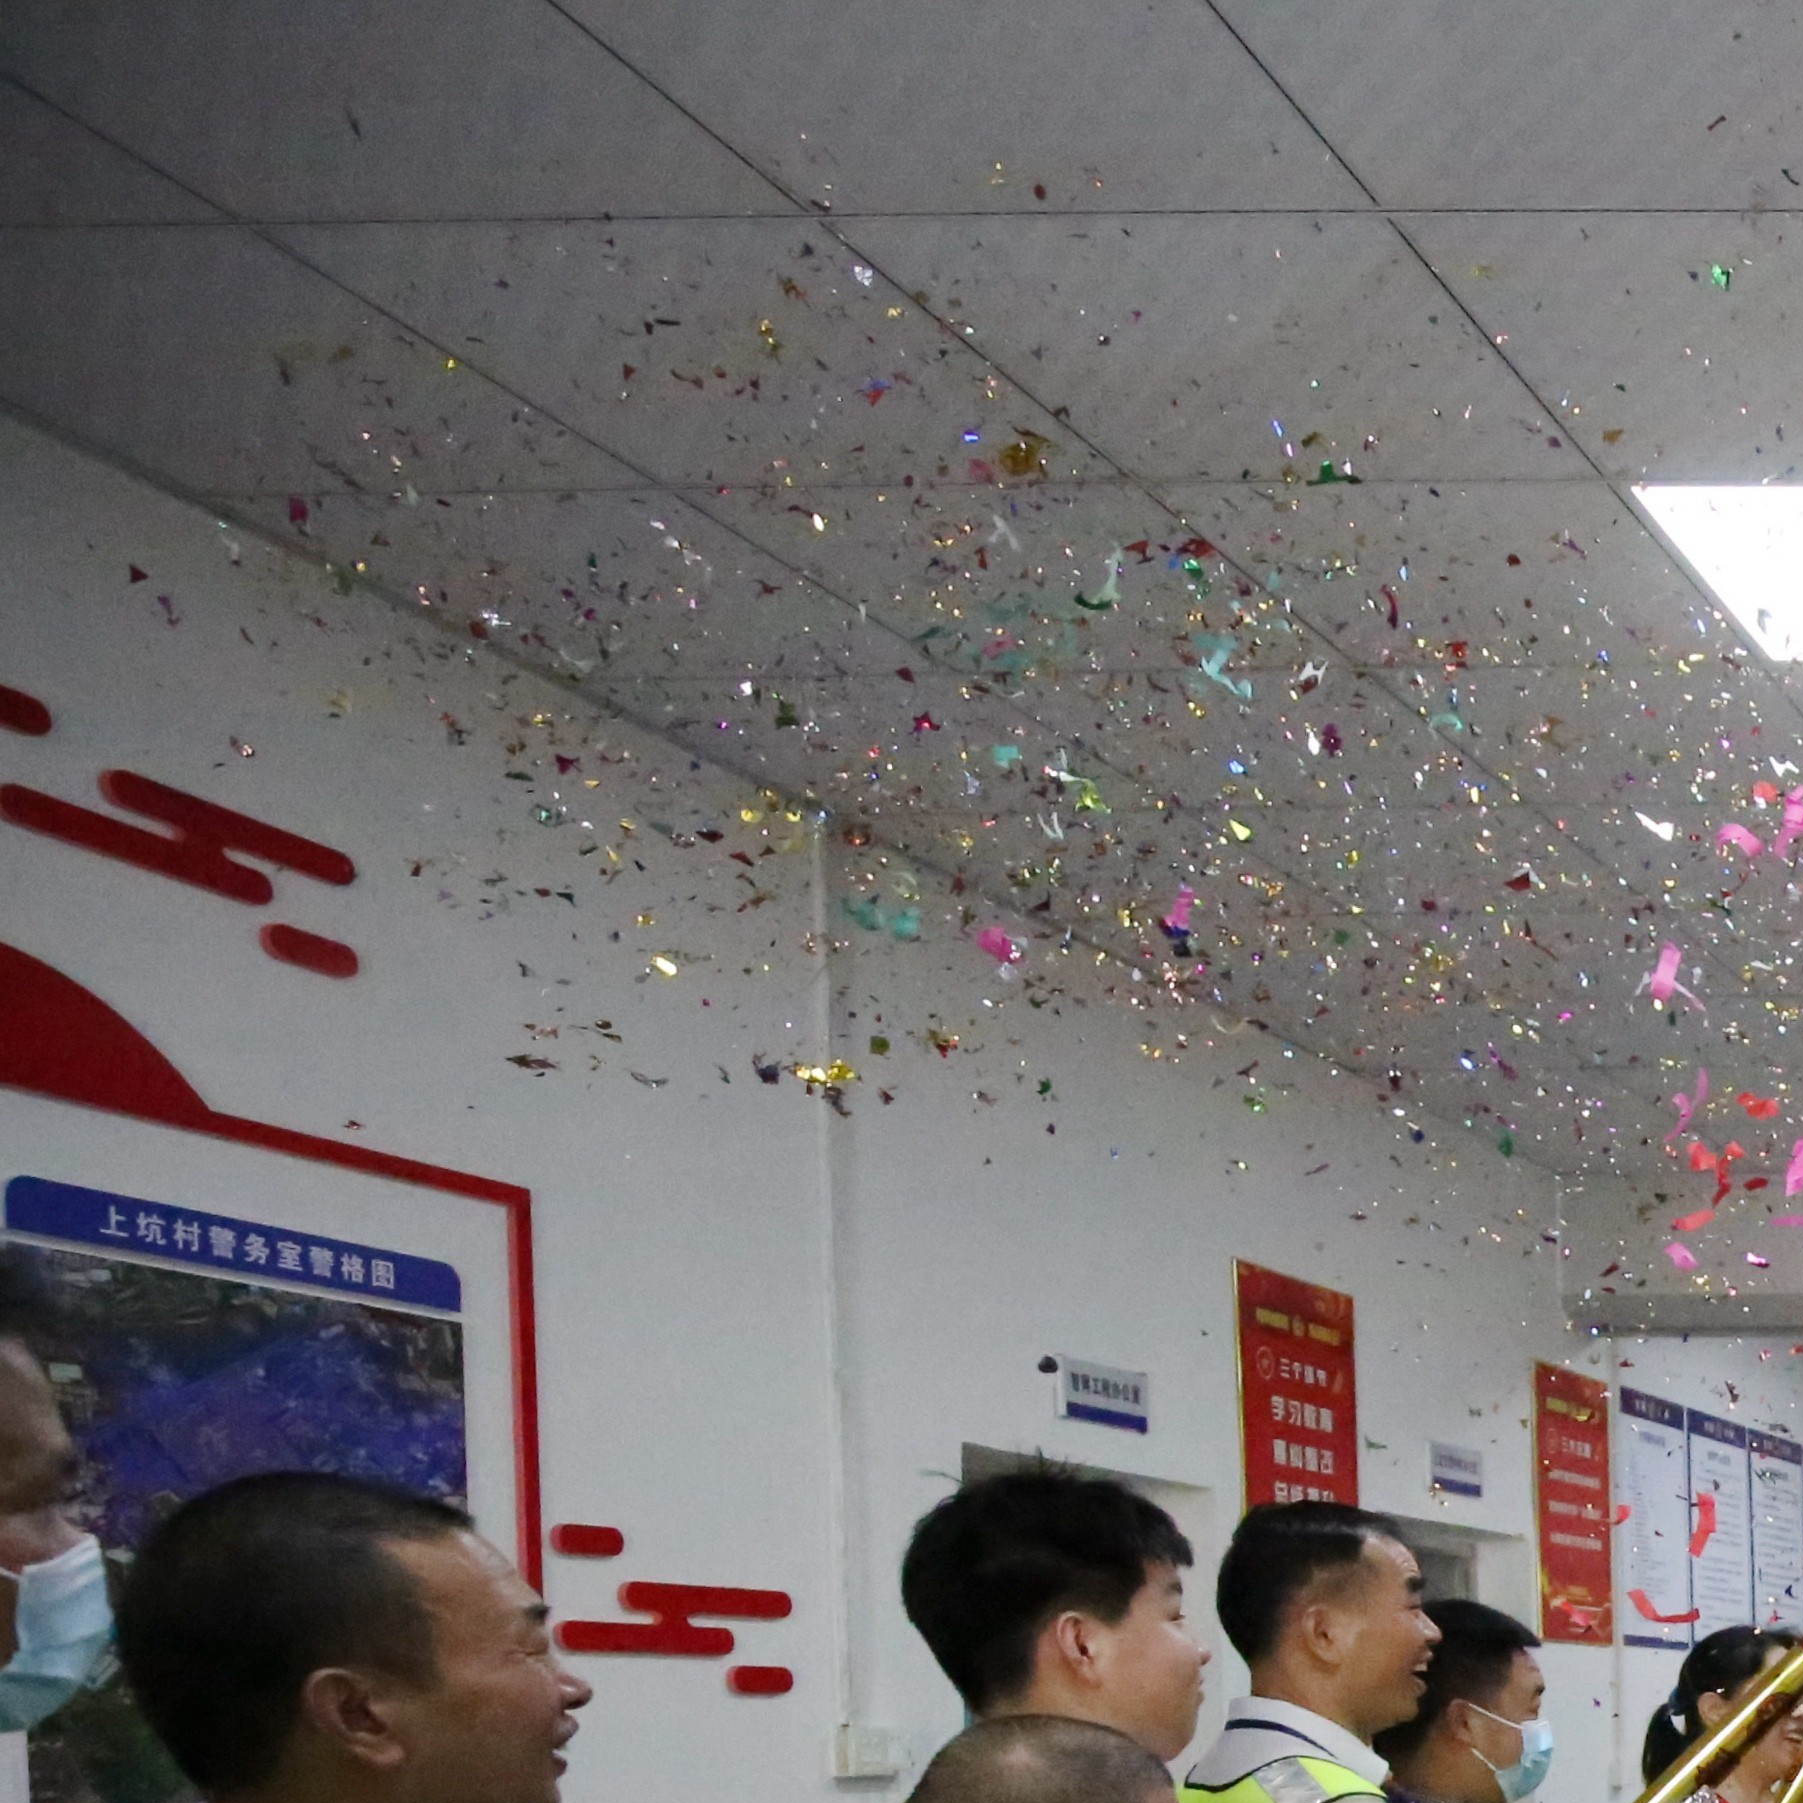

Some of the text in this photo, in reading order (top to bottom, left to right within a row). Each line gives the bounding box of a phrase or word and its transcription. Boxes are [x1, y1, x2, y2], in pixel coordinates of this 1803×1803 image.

[100, 1206, 394, 1289] 上坑村警务室警格图
[1271, 1396, 1333, 1433] 学习教育
